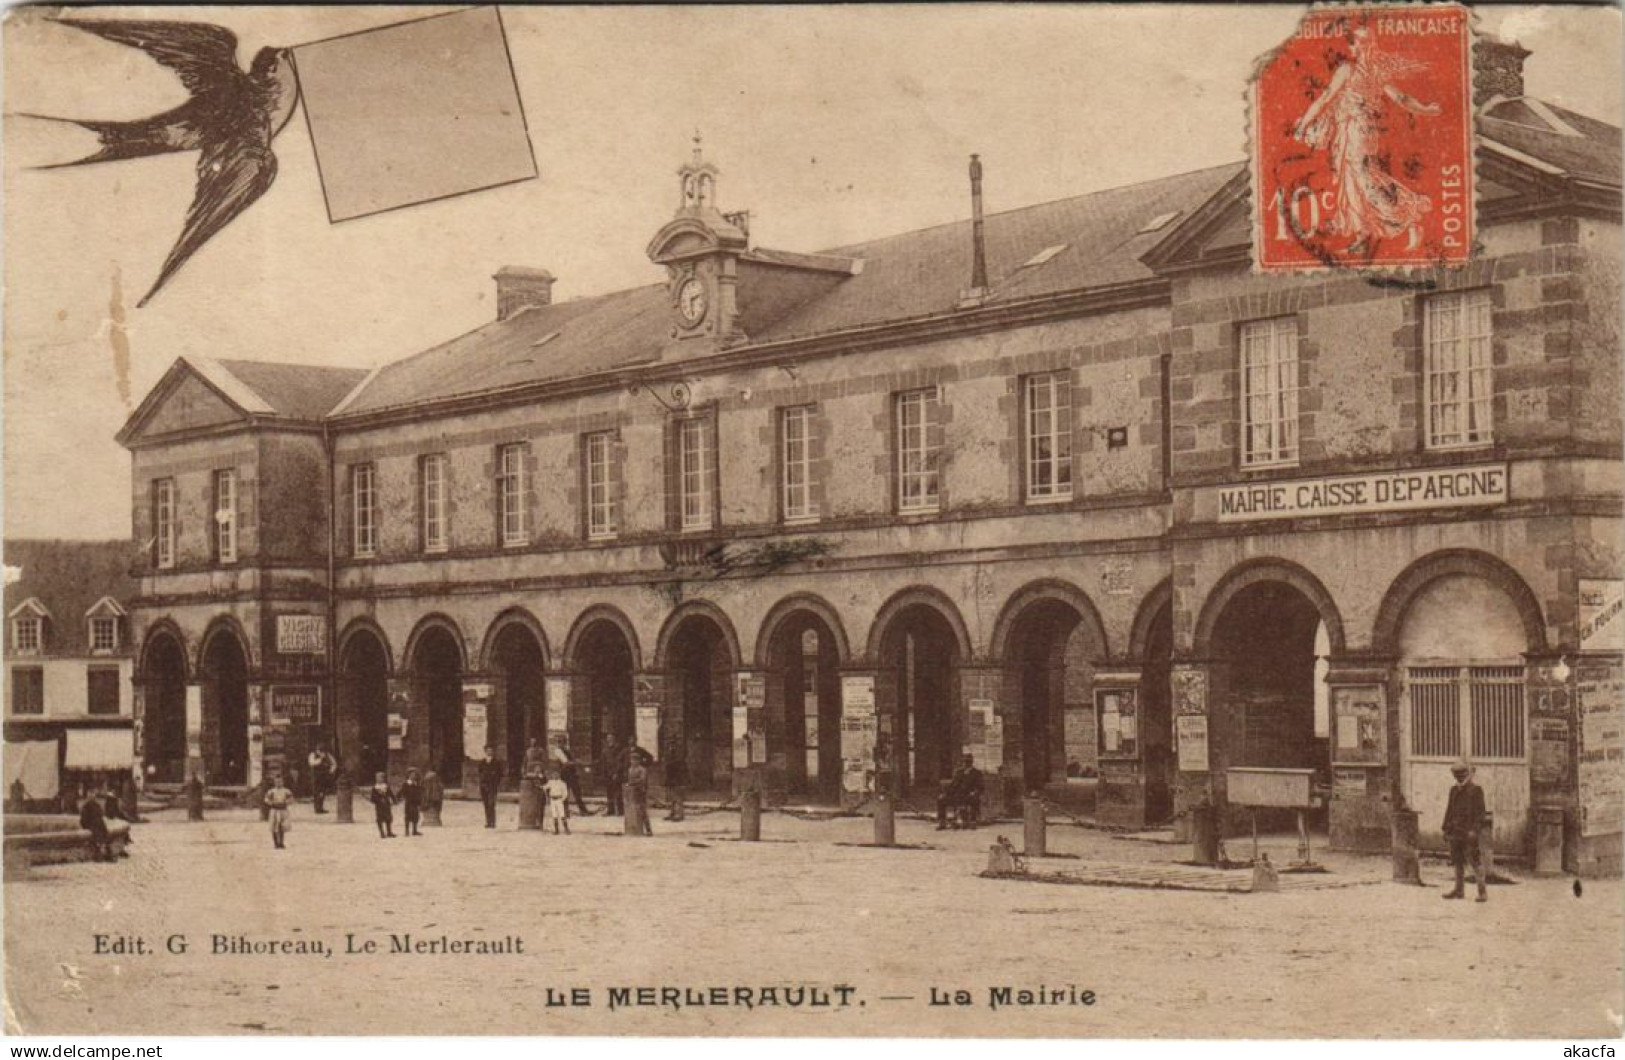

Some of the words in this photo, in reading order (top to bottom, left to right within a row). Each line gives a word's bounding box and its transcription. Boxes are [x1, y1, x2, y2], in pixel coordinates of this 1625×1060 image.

[1378, 17, 1458, 36] FRANÇAISE
[1441, 164, 1462, 247] POSTES
[1297, 481, 1367, 509] CAISSE
